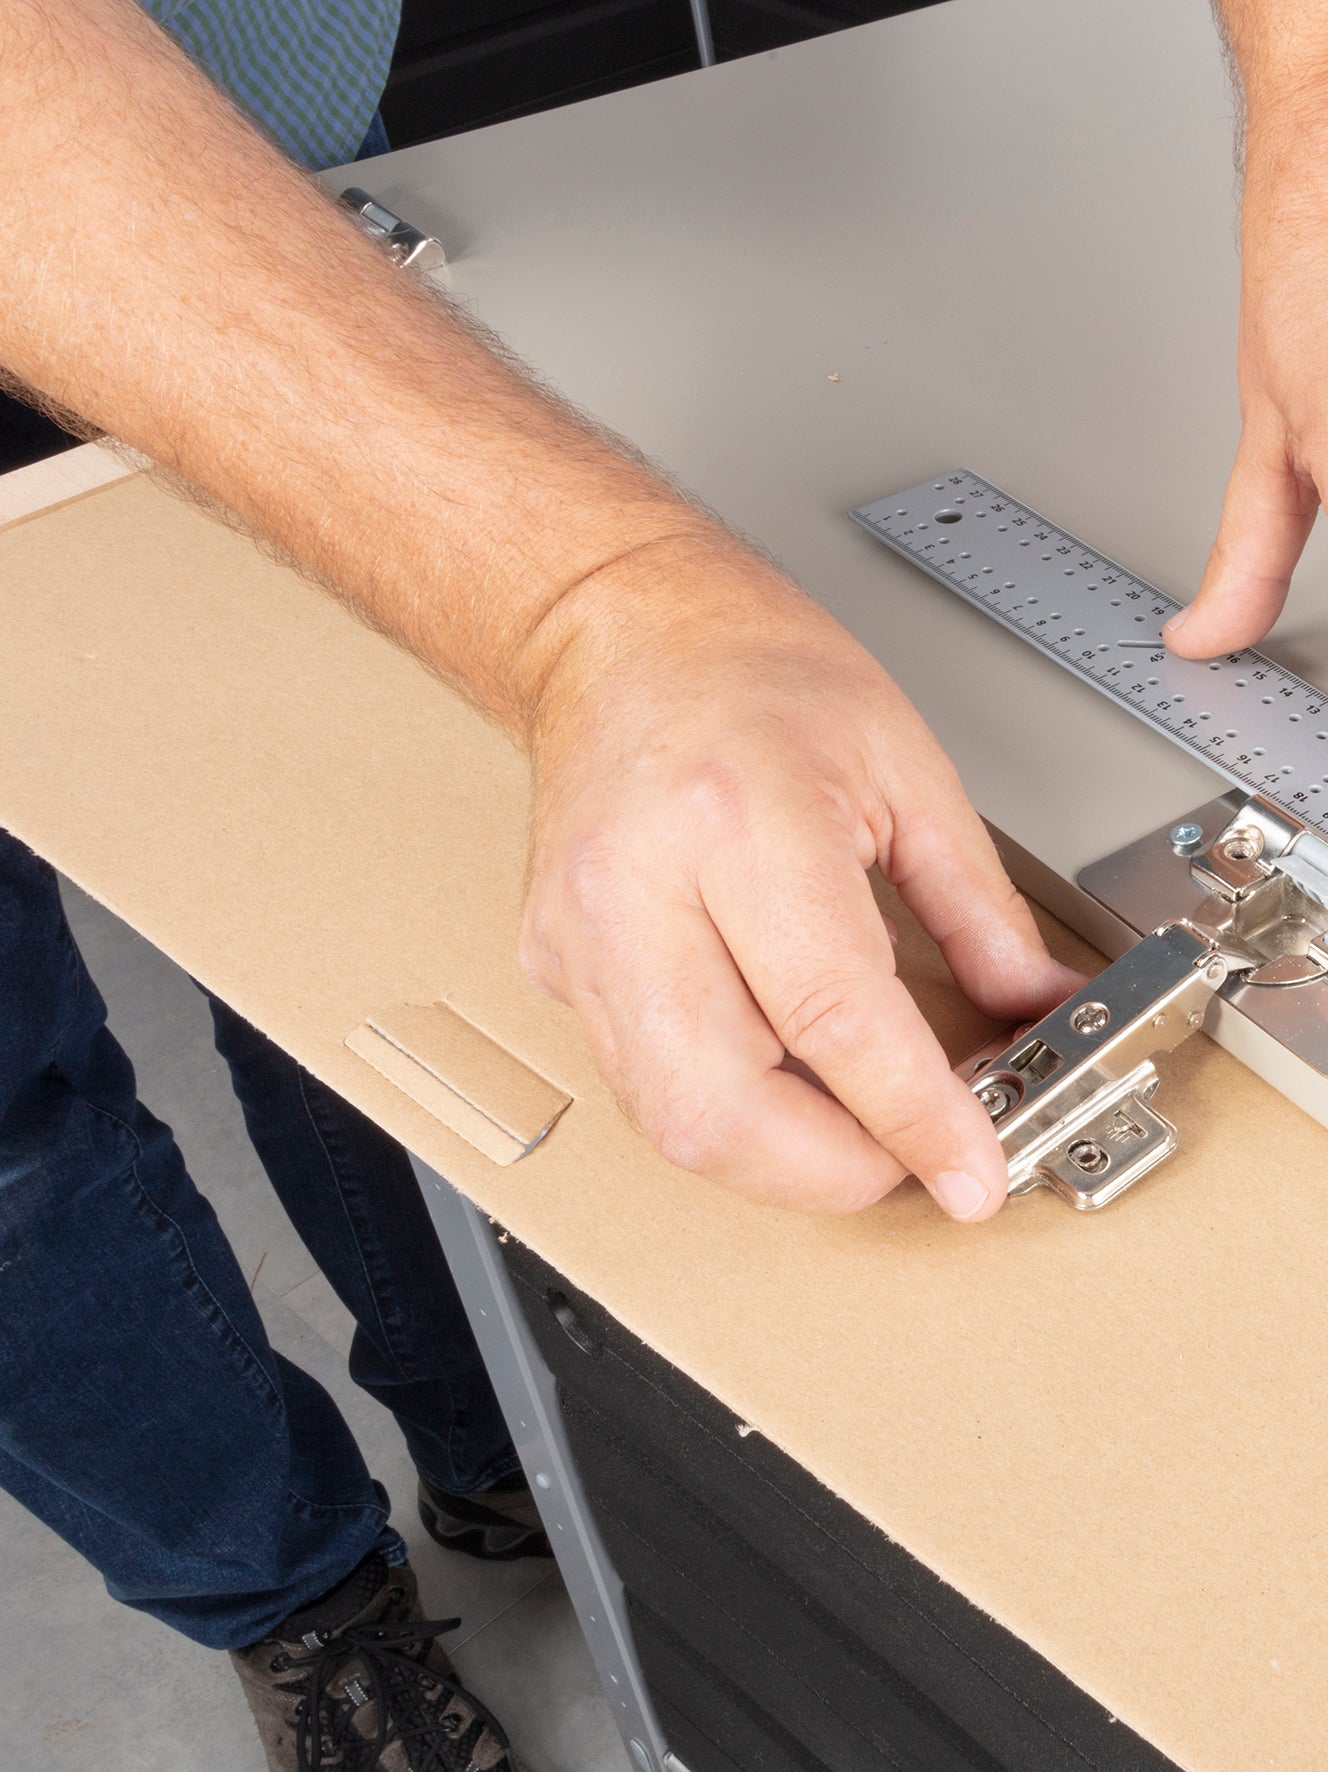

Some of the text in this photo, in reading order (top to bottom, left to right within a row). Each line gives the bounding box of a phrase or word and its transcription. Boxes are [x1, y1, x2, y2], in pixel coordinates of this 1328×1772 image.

[948, 476, 963, 486] 28
[969, 490, 984, 498] 27
[990, 503, 1006, 513] 26
[1011, 517, 1027, 527] 25
[1033, 531, 1049, 541] 24
[1055, 546, 1071, 555] 23
[1078, 560, 1094, 571] 22
[1101, 575, 1117, 585] 21
[1125, 590, 1141, 600] 20
[1013, 604, 1024, 612] 7
[1151, 606, 1166, 616] 19
[1036, 619, 1047, 627] 8
[1081, 650, 1097, 660] 10
[1150, 651, 1168, 664] 45°
[1226, 654, 1241, 664] 16
[1106, 667, 1121, 677] 11
[1252, 670, 1267, 681] 15
[1131, 683, 1146, 694] 12
[1279, 687, 1294, 698] 14
[1157, 701, 1172, 711] 13
[1306, 704, 1321, 715] 13
[1183, 718, 1198, 729] 14
[1209, 736, 1225, 747] 15
[1236, 754, 1252, 765] 16
[1264, 773, 1280, 784] 17
[1293, 791, 1309, 803] 18
